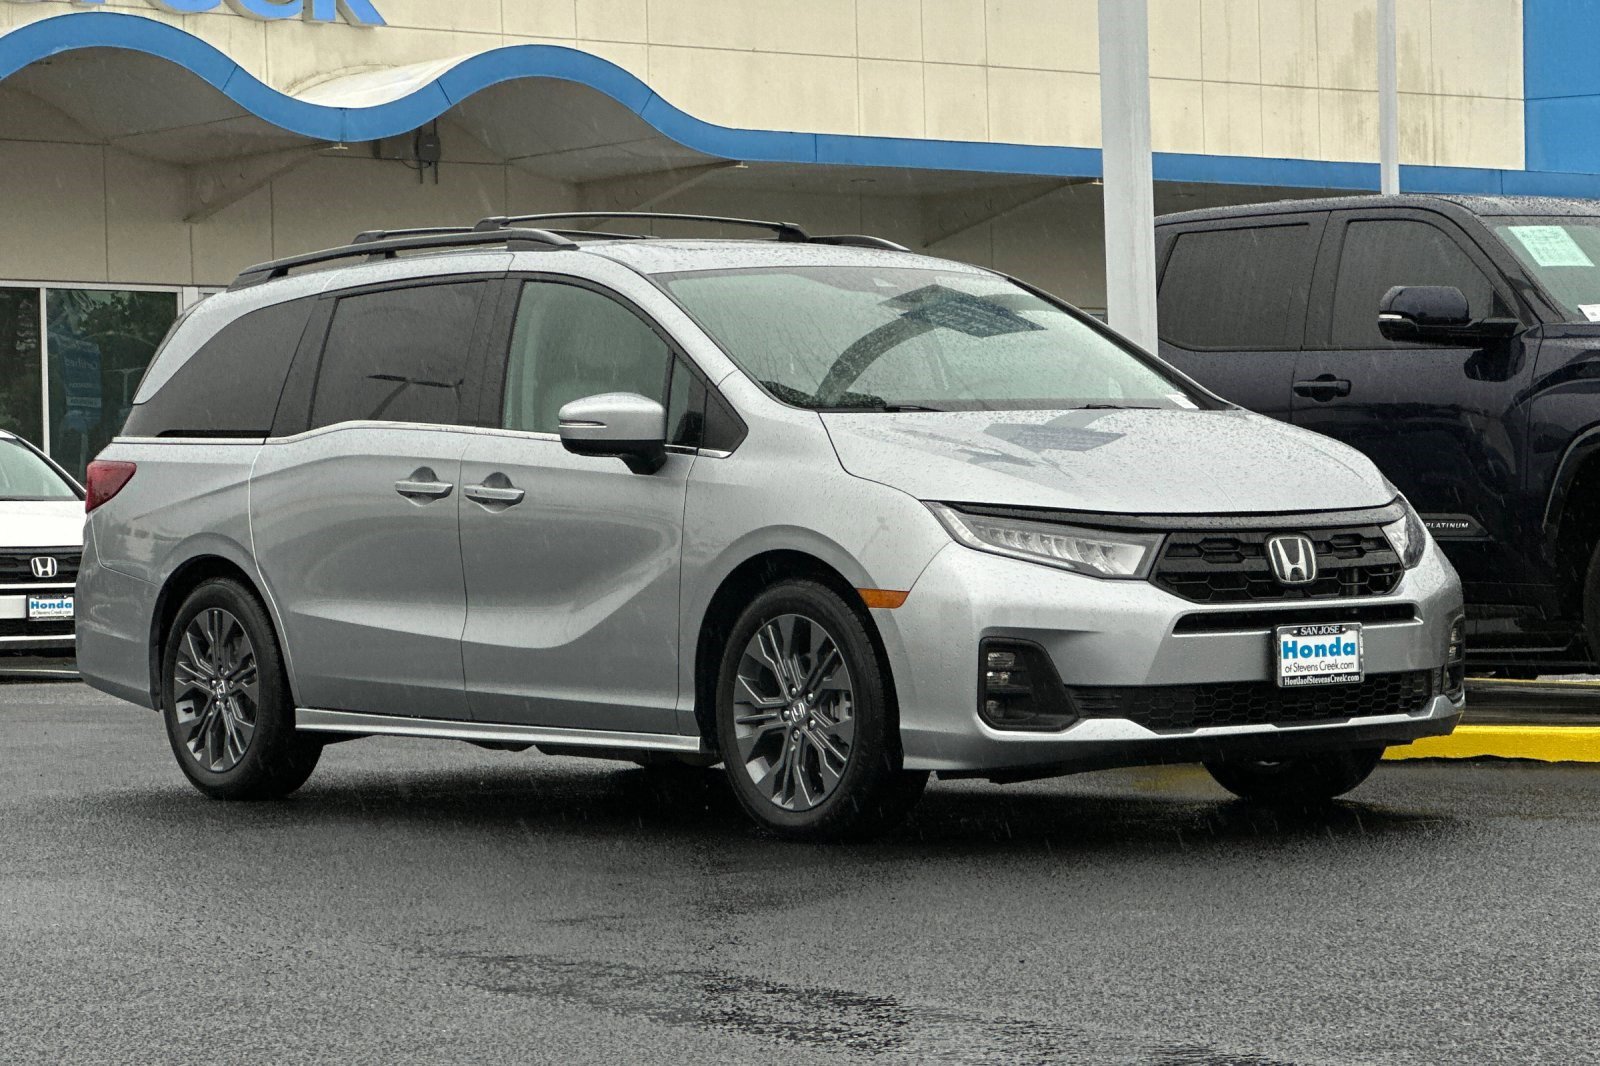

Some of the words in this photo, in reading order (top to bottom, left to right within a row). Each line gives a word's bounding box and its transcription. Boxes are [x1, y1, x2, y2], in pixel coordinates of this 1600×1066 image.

[31, 600, 72, 609] Honda
[1300, 627, 1318, 636] SAN
[1319, 625, 1340, 635] JOSE
[1282, 637, 1356, 659] Honda
[1284, 663, 1293, 673] of
[1293, 662, 1319, 673] Stevens
[1319, 659, 1355, 671] Creek.com
